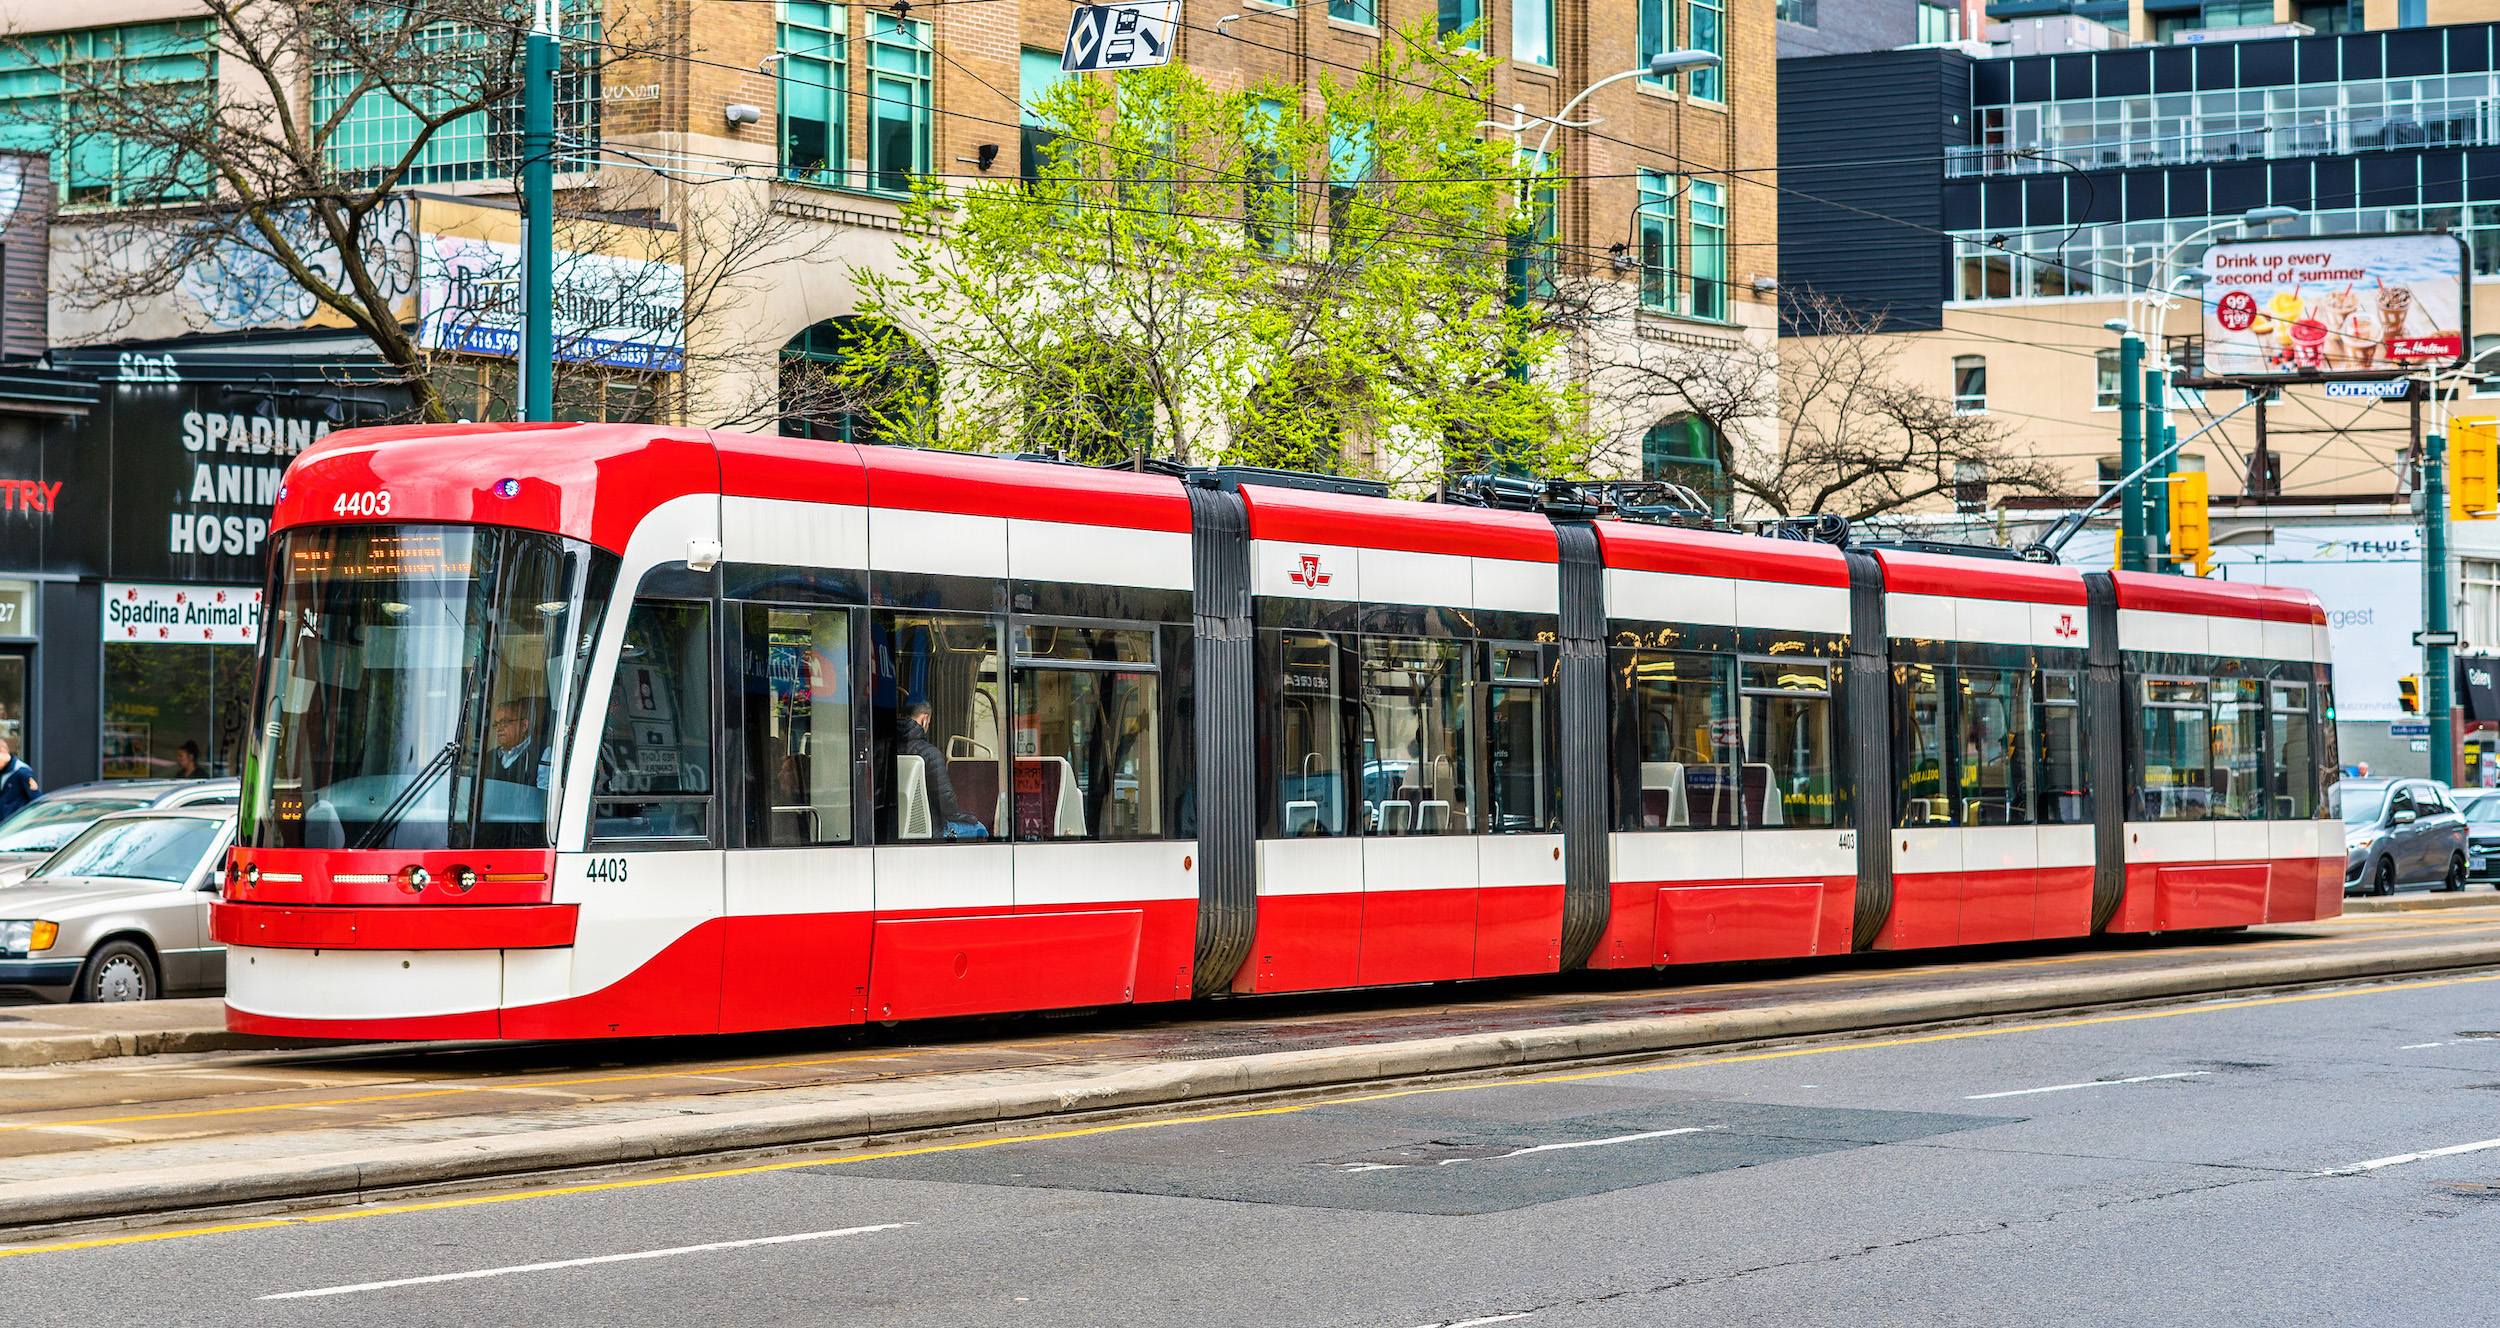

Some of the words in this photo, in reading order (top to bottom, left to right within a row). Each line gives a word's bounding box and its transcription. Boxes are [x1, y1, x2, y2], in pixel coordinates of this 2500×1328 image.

[2216, 254, 2257, 268] Drink
[2263, 255, 2283, 269] up
[2288, 253, 2331, 267] every
[2216, 270, 2272, 285] second
[2277, 268, 2294, 283] of
[2298, 268, 2366, 282] summer
[2328, 383, 2404, 396] OUTFRONT
[190, 463, 281, 506] ANIM
[333, 490, 391, 517] 4403
[169, 513, 270, 556] HOSP
[2352, 540, 2411, 553] TELUS
[109, 598, 179, 627] Spadina
[185, 601, 242, 625] Animal
[2327, 607, 2374, 630] rgest
[1838, 833, 1855, 850] 4403
[586, 858, 627, 882] 4403
